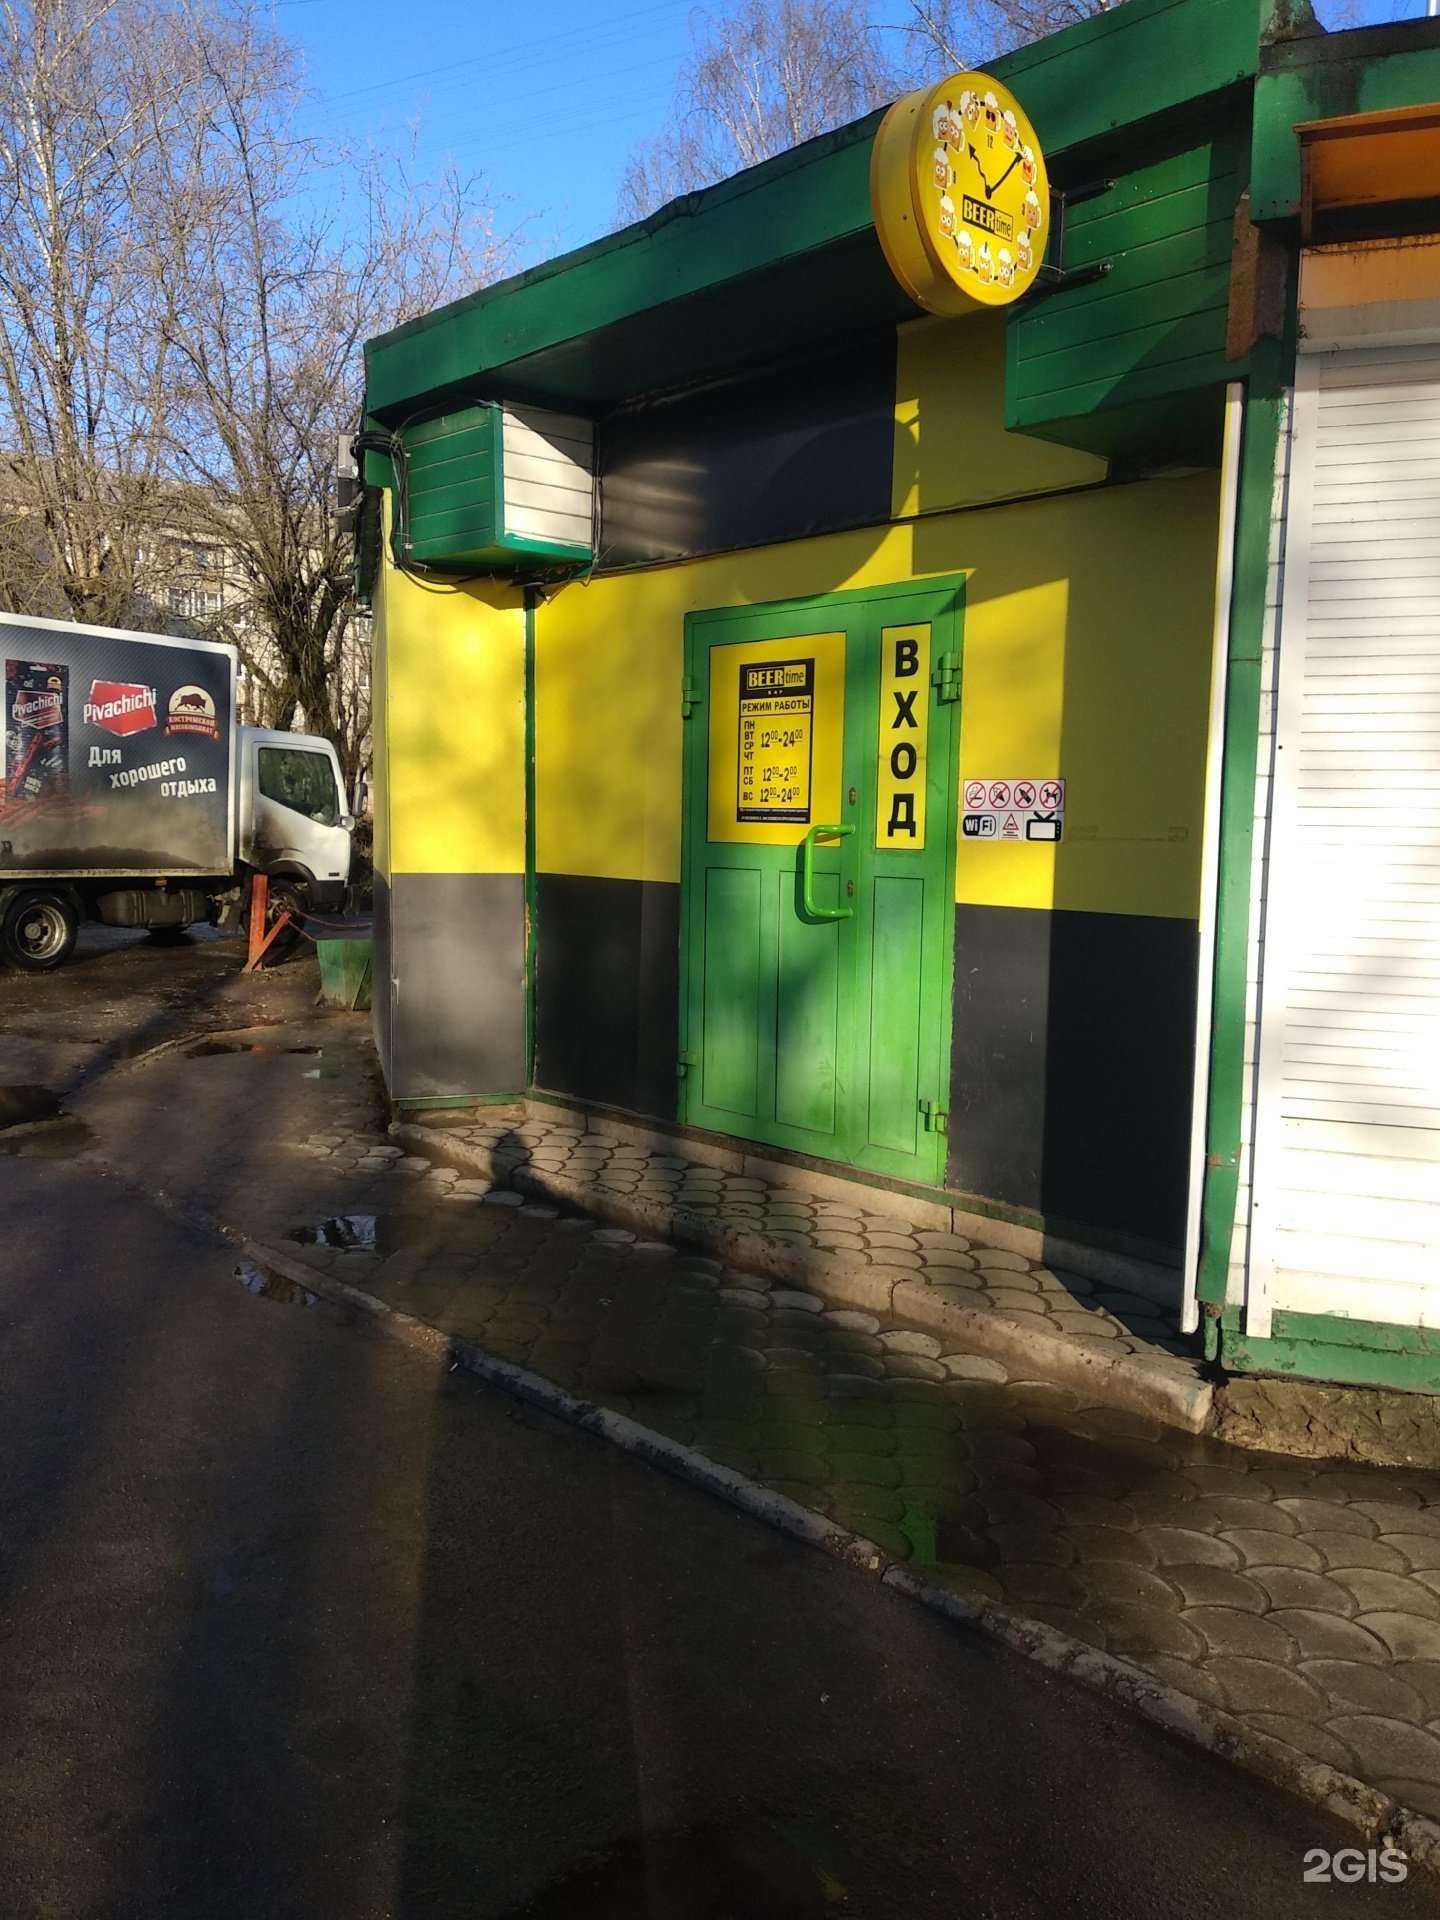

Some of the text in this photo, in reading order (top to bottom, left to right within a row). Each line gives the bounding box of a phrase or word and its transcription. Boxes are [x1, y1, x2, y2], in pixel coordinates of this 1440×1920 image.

[963, 199, 1012, 237] BEER time
[748, 669, 804, 689] BEER time
[83, 688, 157, 724] Pivachichi
[742, 699, 810, 713] РЕЖИМ РАБОТЫ
[744, 720, 755, 730] ПН
[744, 731, 754, 740] ВТ
[888, 639, 920, 838] ВХОД
[744, 741, 754, 750] СР
[88, 746, 122, 768] Для
[743, 752, 754, 760] ЧТ
[109, 756, 187, 788] хорошего
[743, 766, 754, 776] ПТ
[160, 777, 217, 798] отдыха
[743, 776, 753, 785] СБ
[743, 791, 753, 801] ВС
